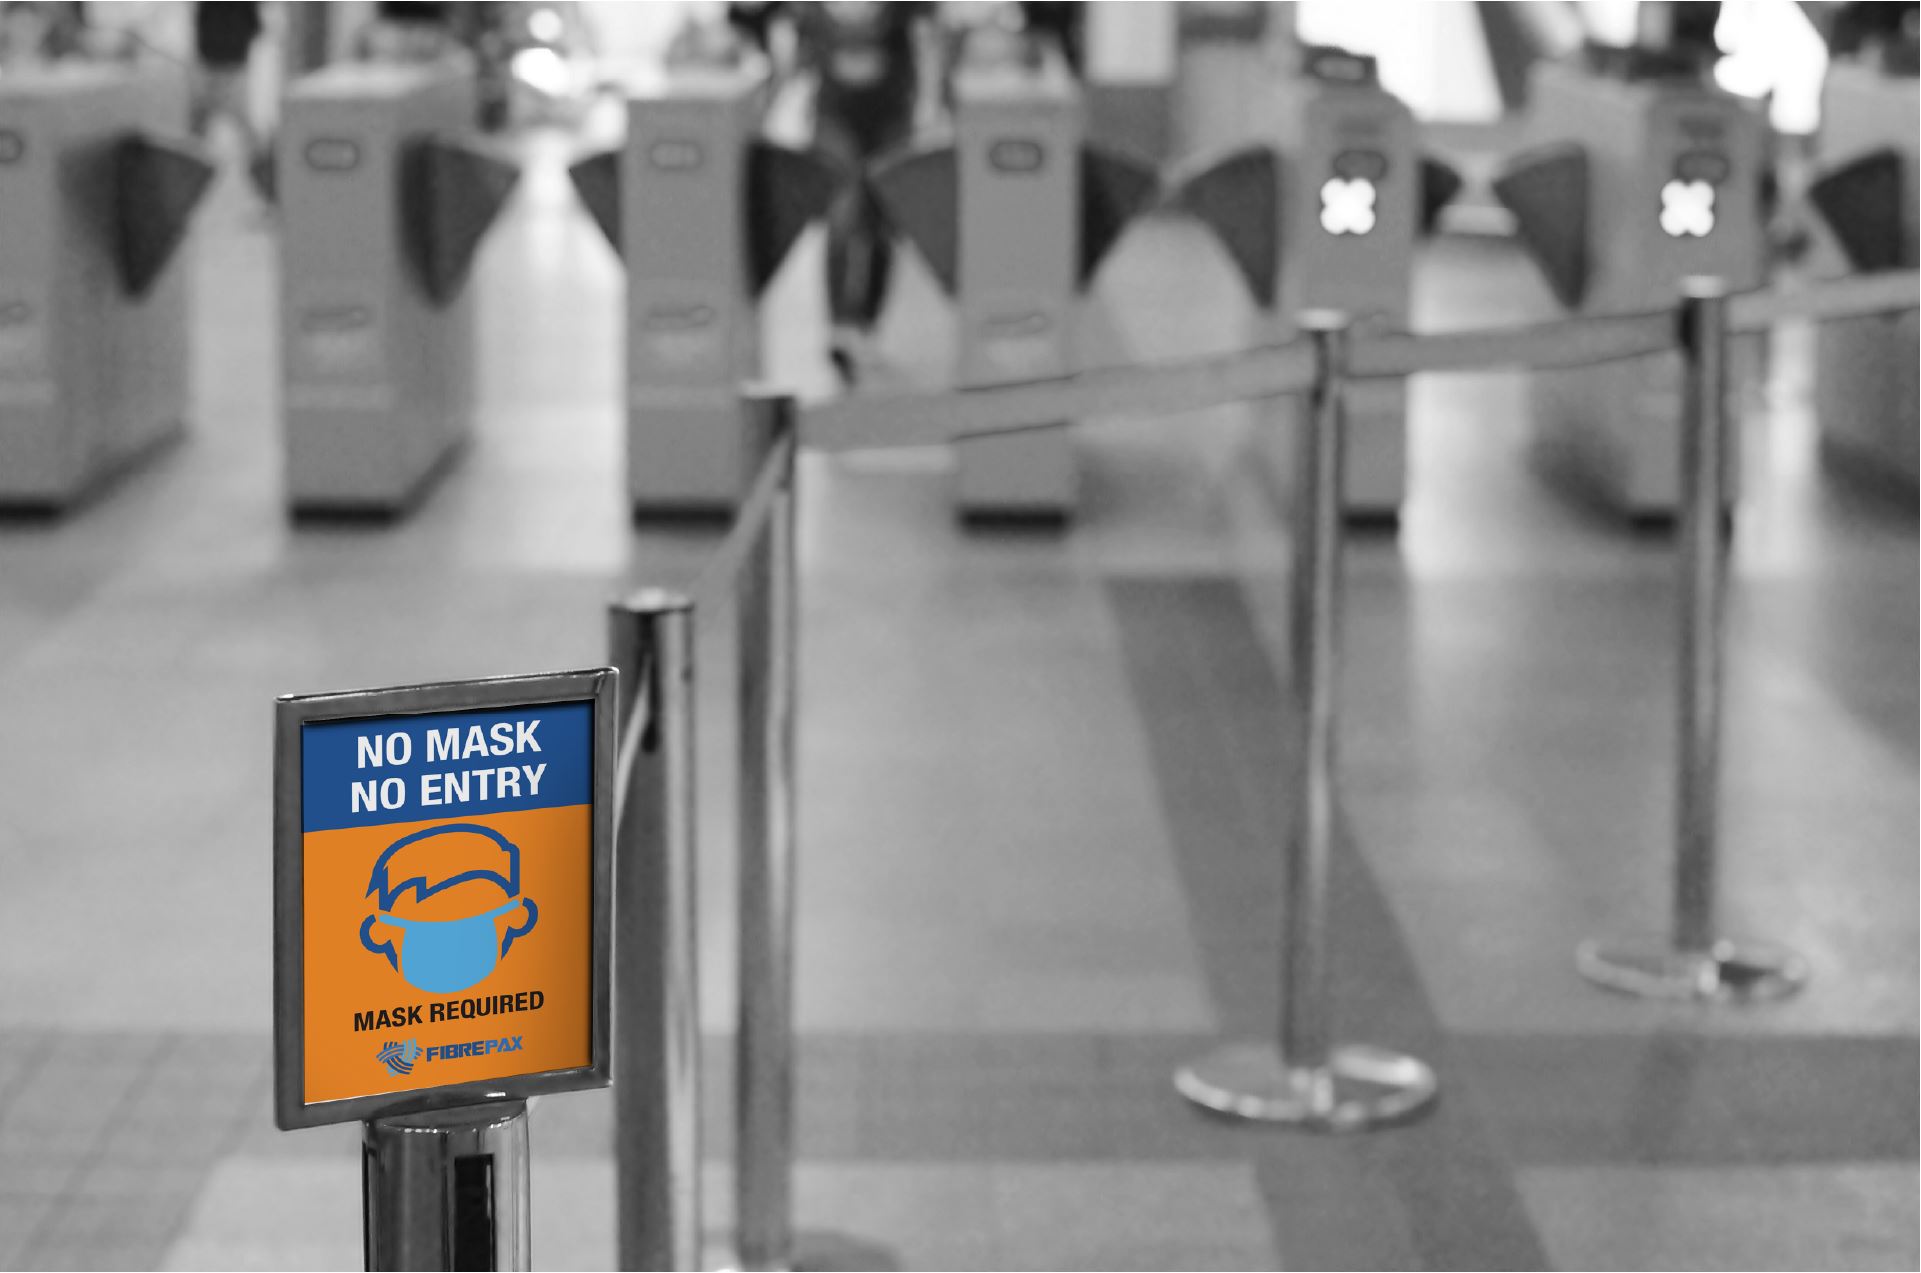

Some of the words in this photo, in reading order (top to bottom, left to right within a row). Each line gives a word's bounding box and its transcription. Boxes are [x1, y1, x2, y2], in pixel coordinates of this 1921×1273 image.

[357, 732, 412, 769] NO
[426, 720, 542, 763] MASK
[351, 777, 406, 813] NO
[421, 763, 548, 807] ENTRY
[354, 1005, 423, 1032] MASK
[430, 991, 544, 1023] REQUIRED
[426, 1035, 523, 1062] FIBREPAX
